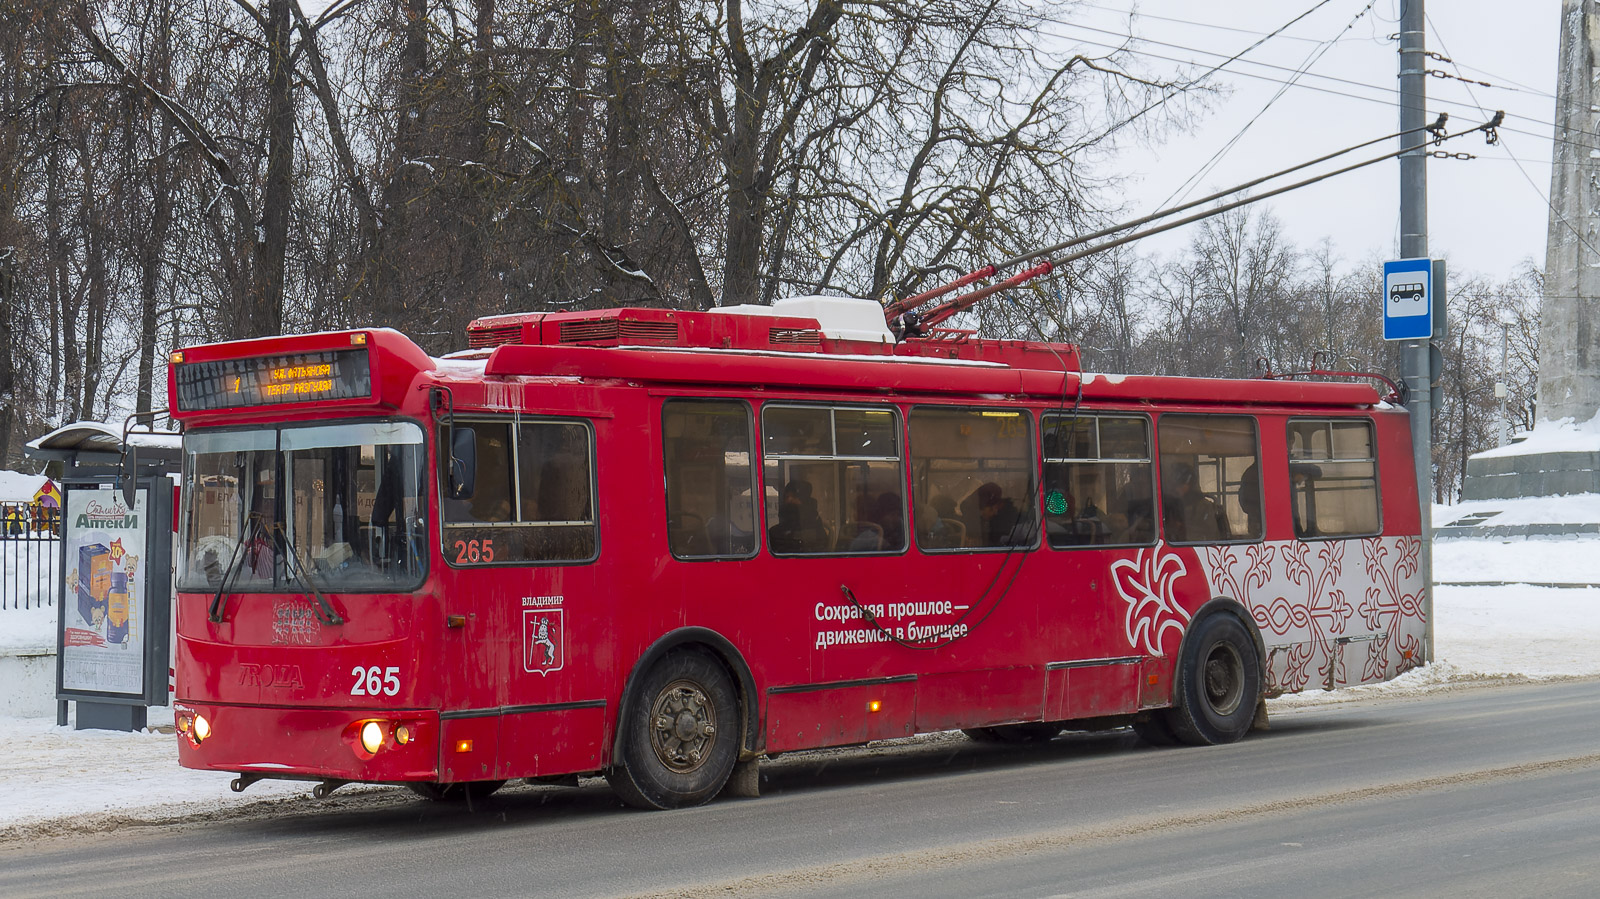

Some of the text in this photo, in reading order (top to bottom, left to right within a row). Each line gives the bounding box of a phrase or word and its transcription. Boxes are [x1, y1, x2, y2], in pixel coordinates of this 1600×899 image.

[273, 364, 331, 379] УЛ. ФАТЬЯНОВА
[233, 377, 241, 394] 1
[266, 383, 291, 396] ТЕАТР
[996, 416, 1027, 439] 265
[454, 539, 494, 564] 265
[521, 596, 564, 607] ВЛАДИМИР
[814, 602, 885, 624] Сохраняя
[815, 621, 968, 650] движемся в будущее
[350, 665, 401, 696] 265
